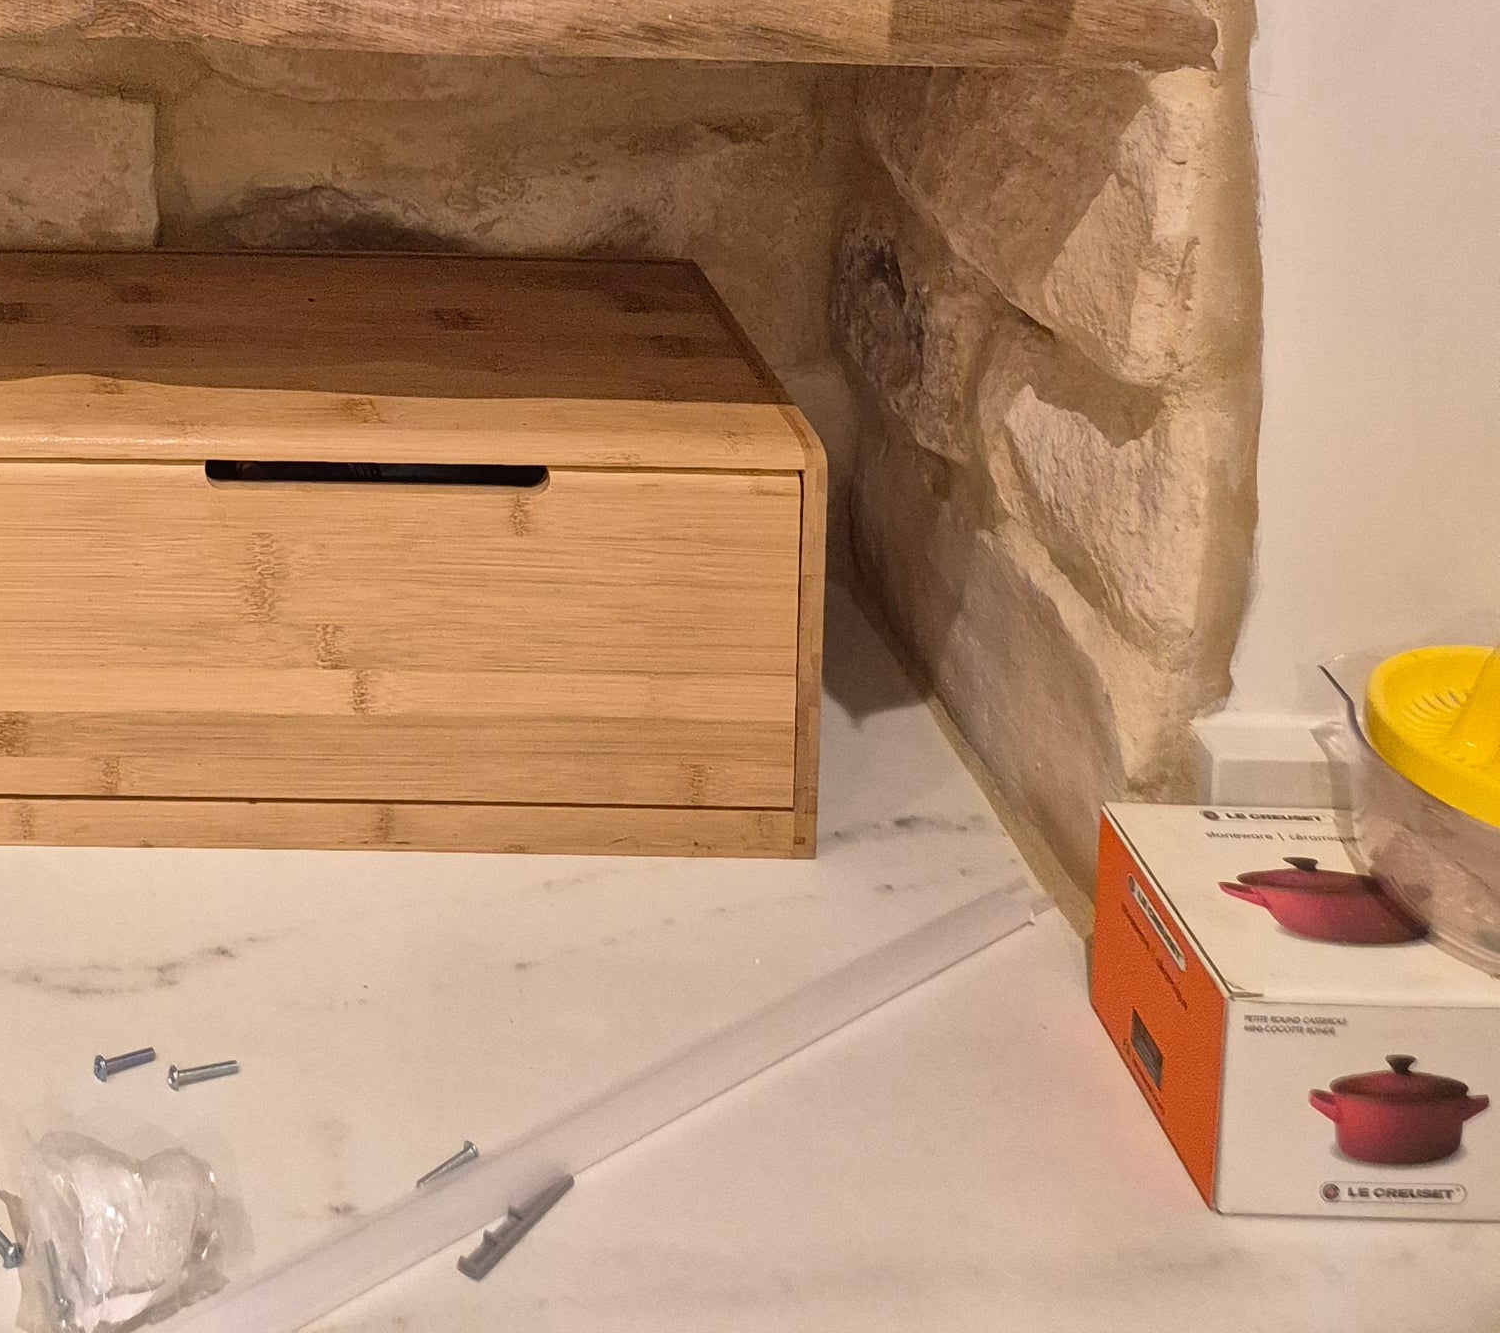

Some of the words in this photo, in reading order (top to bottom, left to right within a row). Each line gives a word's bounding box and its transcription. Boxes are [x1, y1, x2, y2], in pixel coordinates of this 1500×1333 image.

[1224, 812, 1247, 820] LE
[1249, 813, 1322, 822] CREUSET
[1205, 831, 1274, 840] stoneware
[1270, 1015, 1301, 1024] ROUND
[1347, 1186, 1370, 1198] LE
[1373, 1187, 1454, 1200] CREUSET
